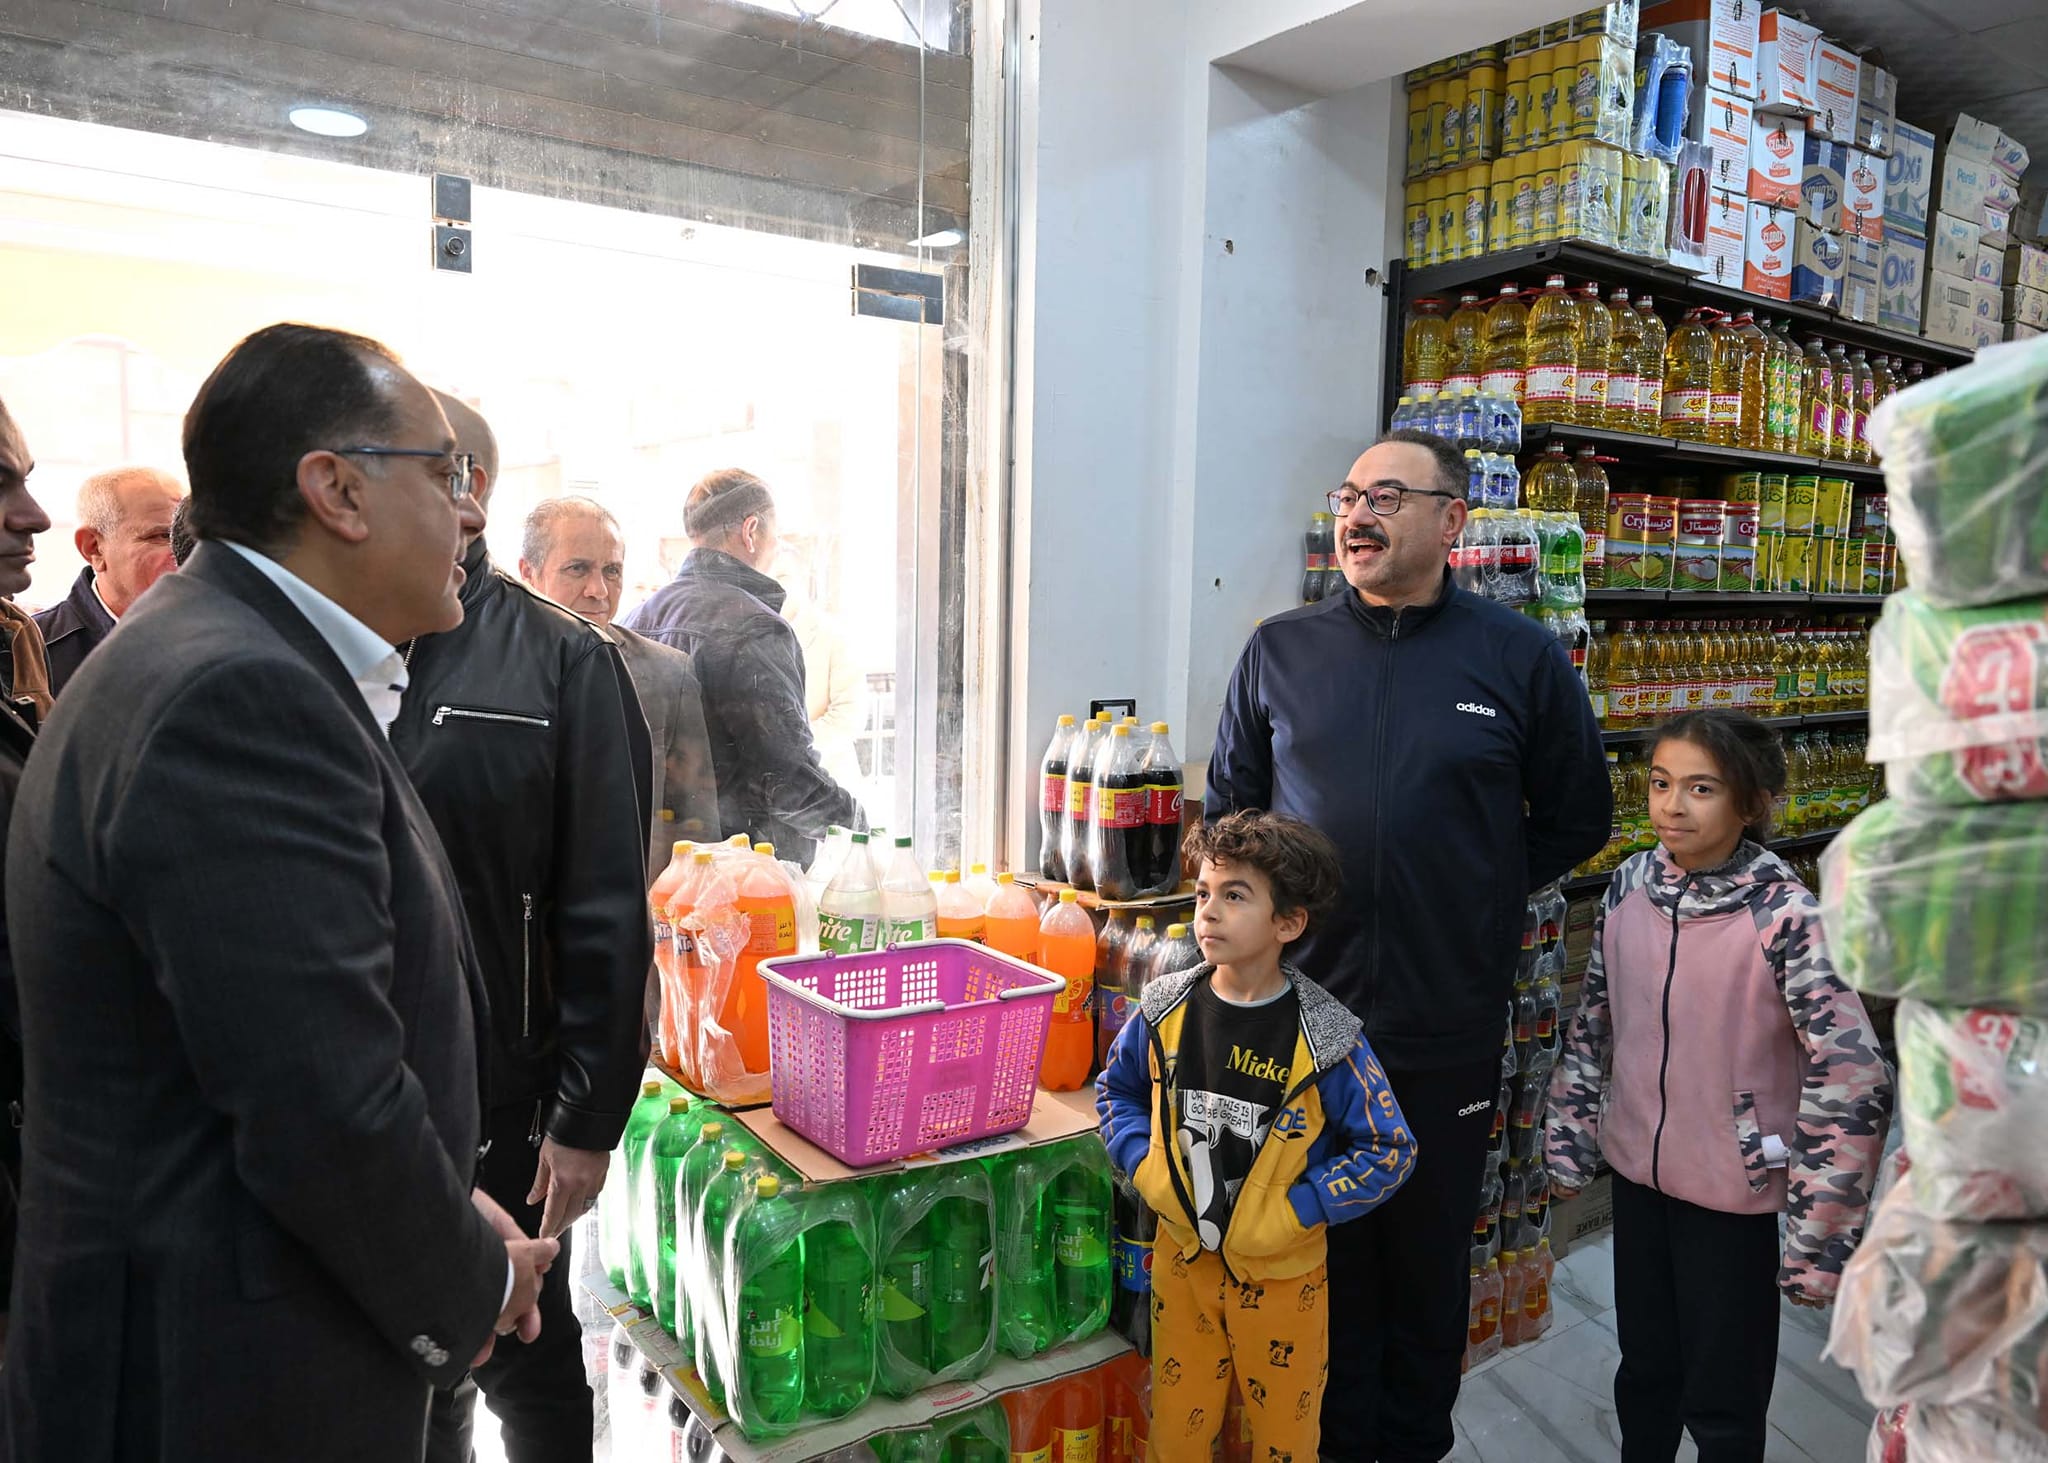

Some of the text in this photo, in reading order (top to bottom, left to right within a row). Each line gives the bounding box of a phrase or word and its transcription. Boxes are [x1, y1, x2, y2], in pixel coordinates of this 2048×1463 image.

[1886, 152, 1922, 186] Oxi
[1883, 255, 1915, 288] Oxi
[1456, 701, 1496, 717] adidas
[818, 917, 852, 941] rite
[1225, 1044, 1290, 1083] Micke
[1218, 1098, 1240, 1112] THIS
[1241, 1106, 1249, 1117] IS
[1458, 1100, 1490, 1116] adidas
